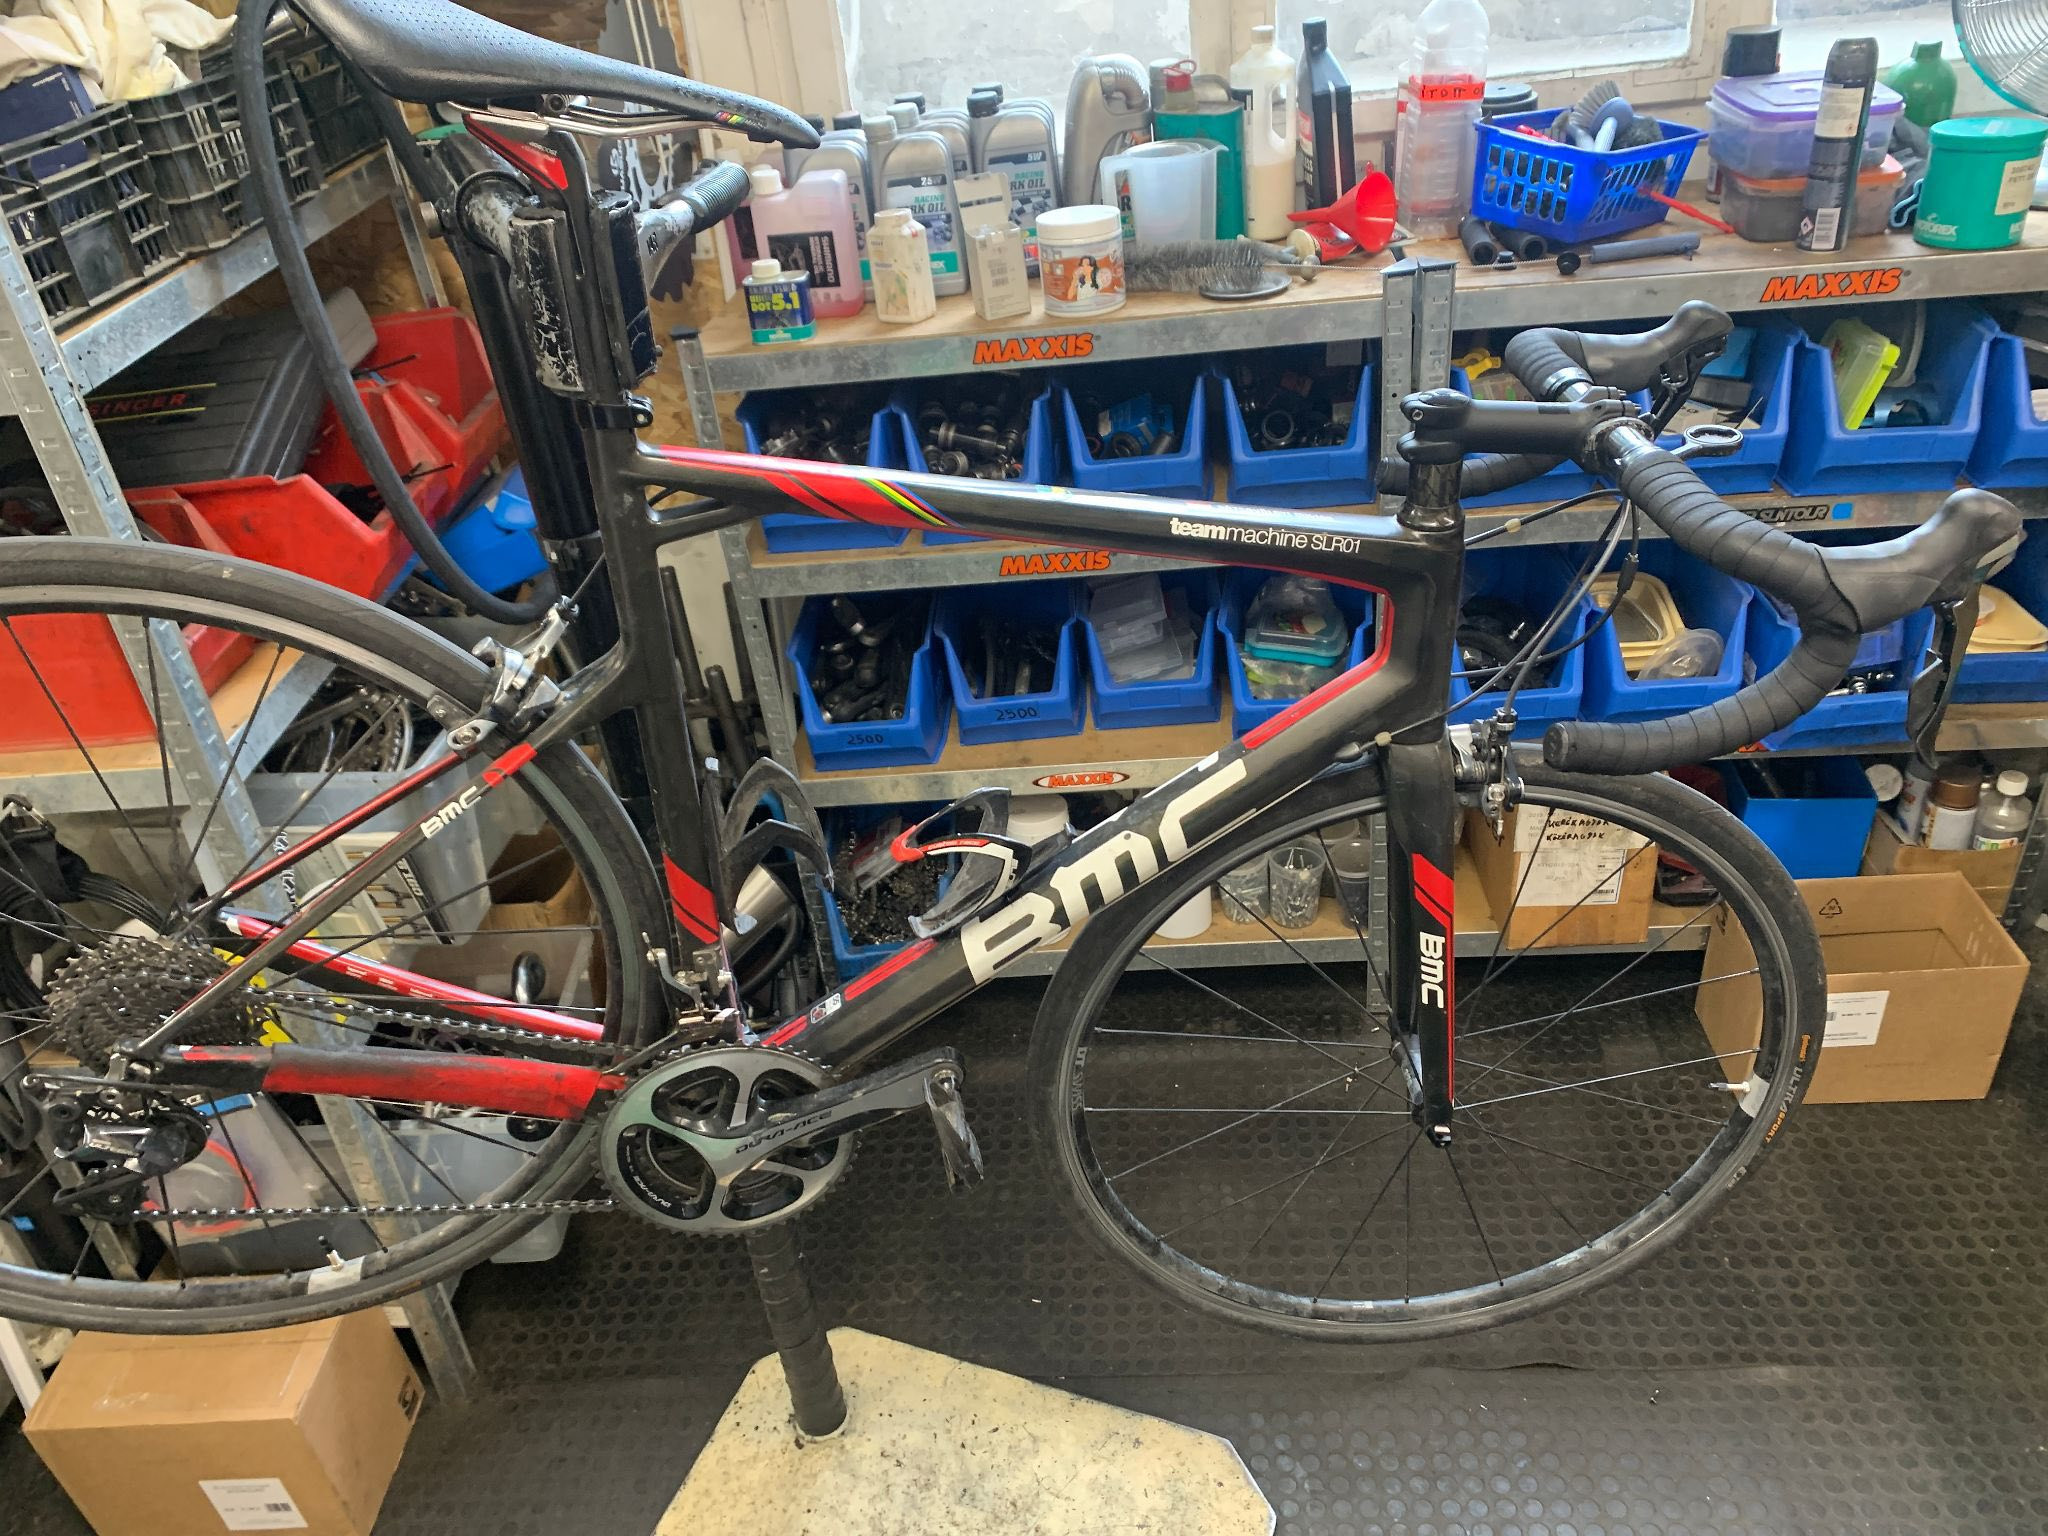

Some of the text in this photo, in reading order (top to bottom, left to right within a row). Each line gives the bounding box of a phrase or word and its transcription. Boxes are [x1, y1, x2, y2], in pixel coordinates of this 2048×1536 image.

[1027, 178, 1046, 189] OIL
[928, 202, 947, 213] OIL
[1760, 268, 1904, 303] MAXXIS
[771, 291, 801, 311] 5.1
[973, 332, 1094, 365] MAXXIS
[1759, 504, 1830, 523] SUNTOUR
[1310, 534, 1361, 554] SLR01
[999, 550, 1111, 577] MAXXIS
[996, 706, 1039, 721] 2500
[847, 733, 884, 745] 2500
[1049, 771, 1115, 788] MAXXIS
[420, 785, 482, 840] BMC
[961, 758, 1256, 985] BMC
[1420, 931, 1446, 1009] BMC
[1764, 1066, 1803, 1144] ULTRA SPORT
[735, 1110, 832, 1154] DURA-ACE
